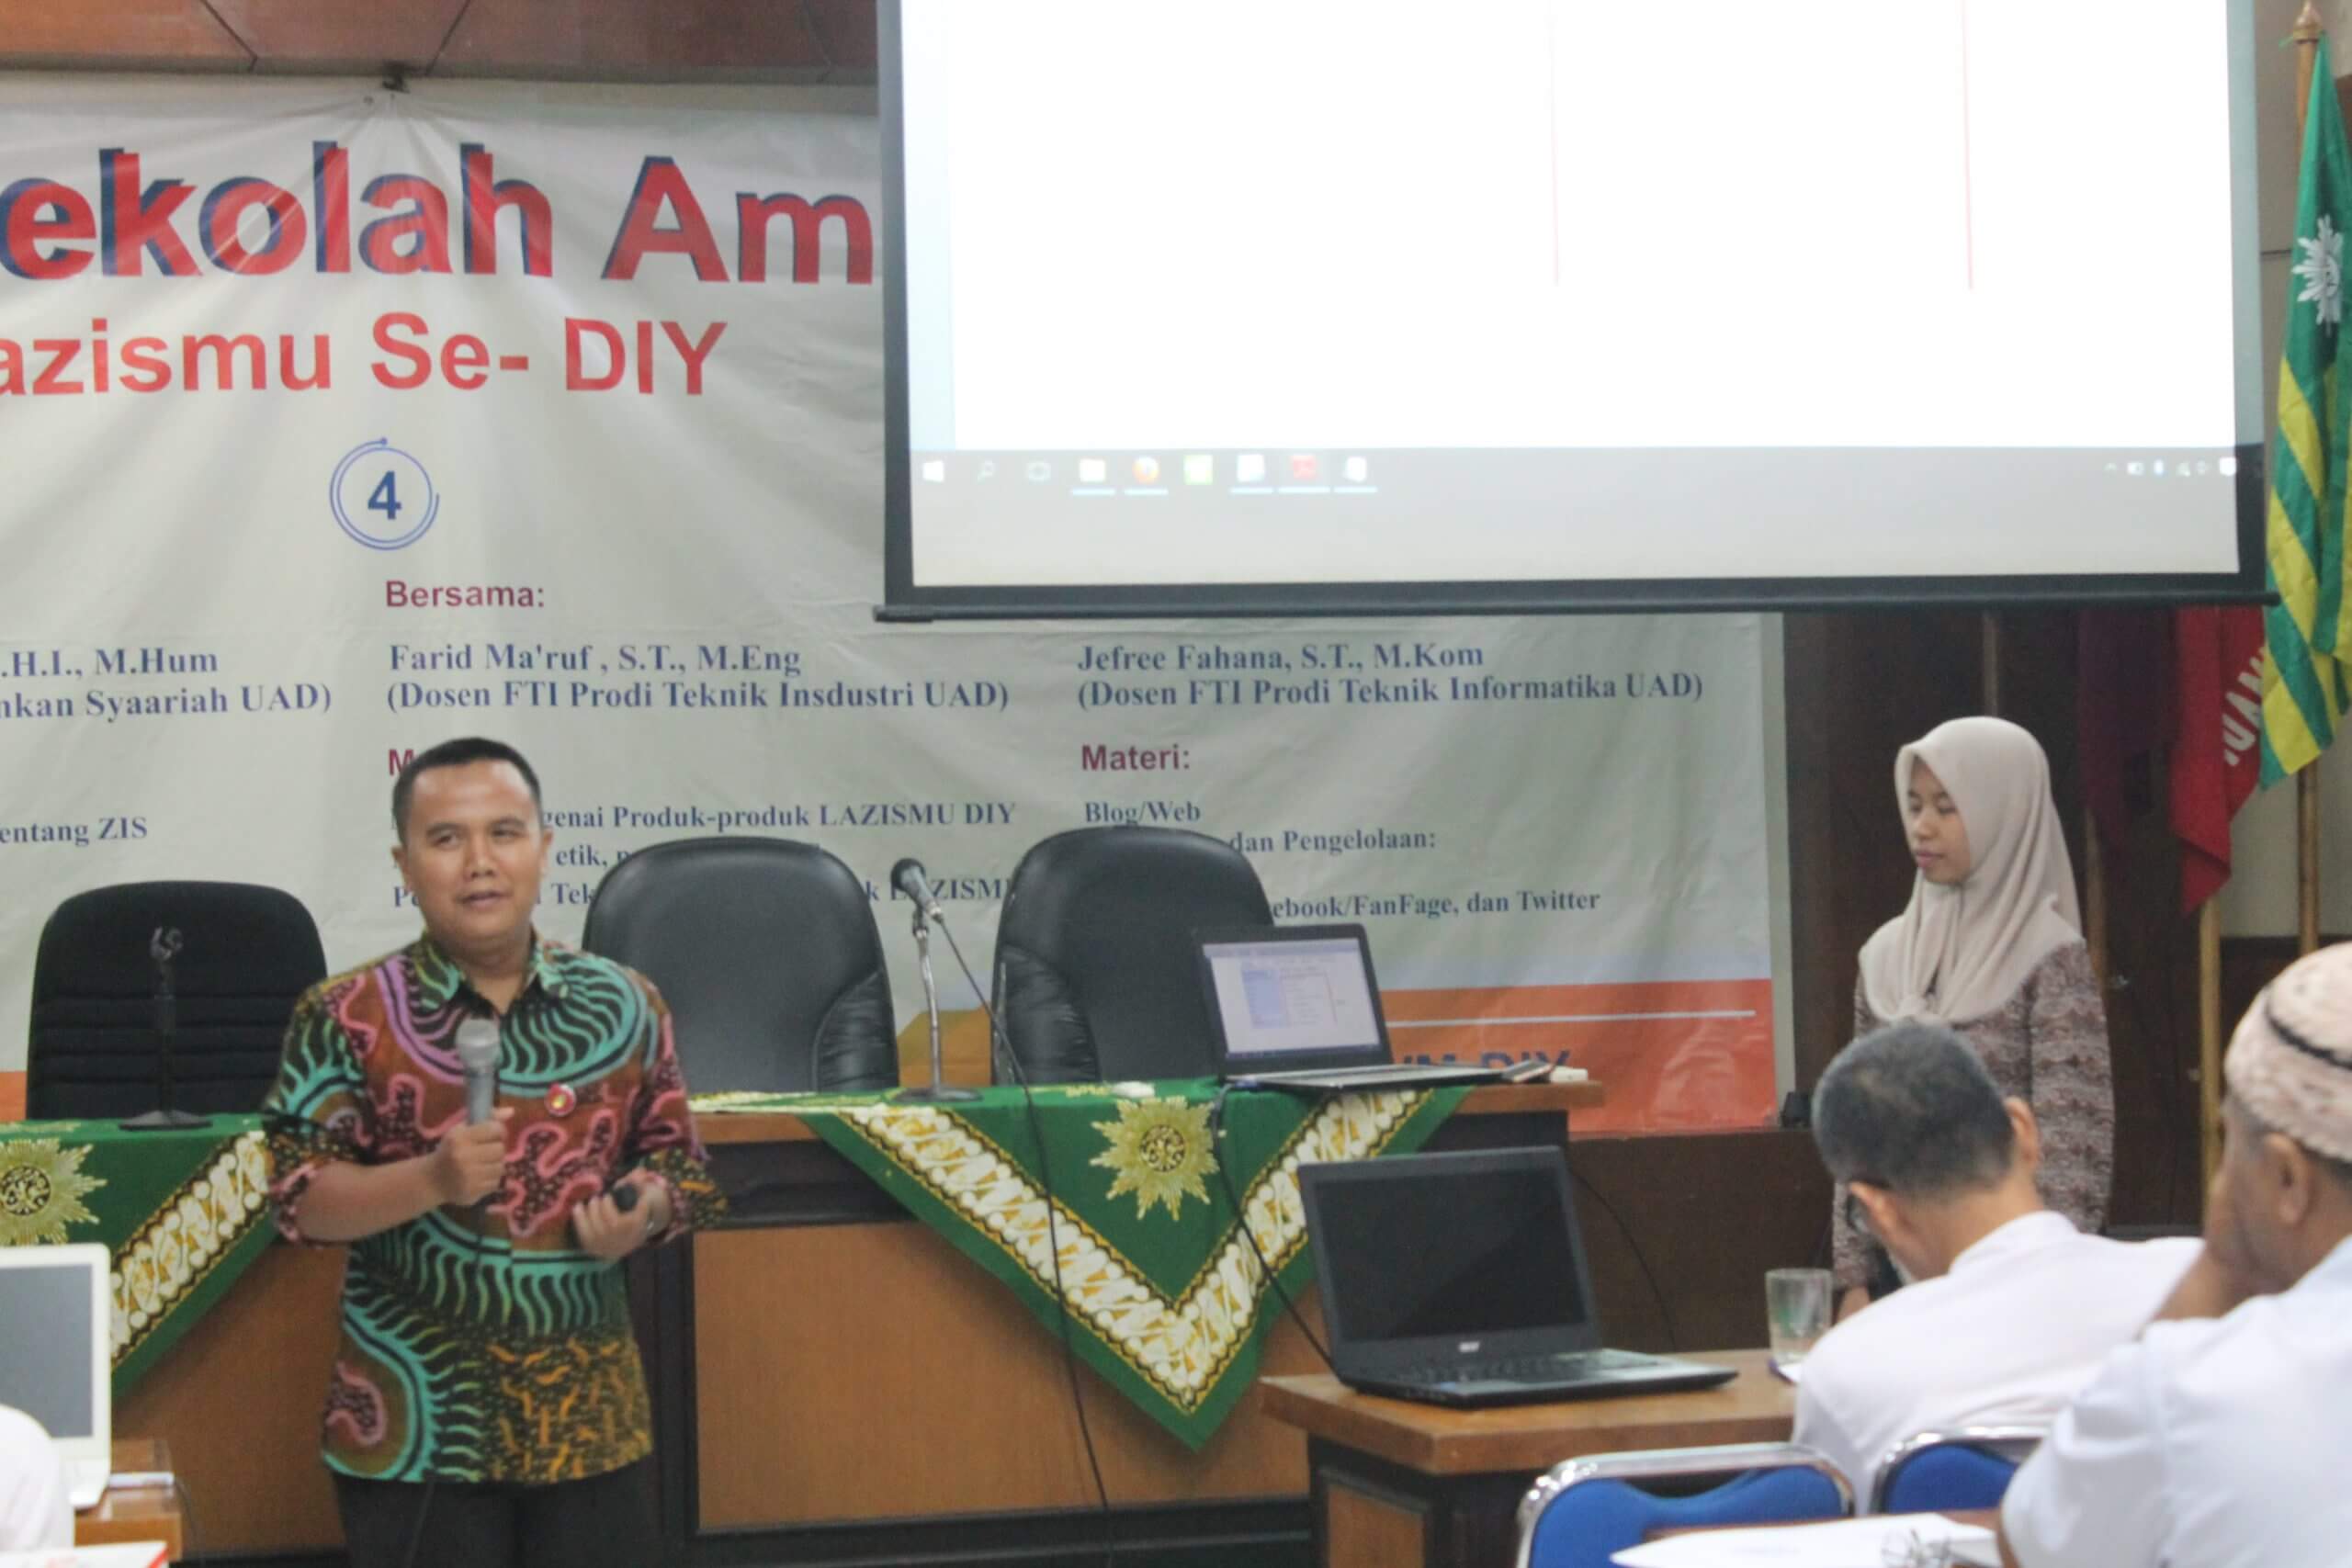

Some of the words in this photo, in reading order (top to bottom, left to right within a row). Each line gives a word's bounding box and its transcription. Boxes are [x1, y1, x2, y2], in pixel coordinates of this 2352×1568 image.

[0, 141, 553, 280] ekolah
[599, 155, 874, 285] Am
[370, 311, 529, 390] Se-
[565, 317, 728, 396] DIY
[367, 469, 401, 521] 4
[385, 581, 545, 608] Bersama:
[95, 647, 219, 675] M.Hum
[390, 644, 472, 671] Farid
[617, 645, 686, 673] S.T.,
[697, 645, 801, 676] M.Eng
[1078, 646, 1167, 671] Jefree
[1177, 646, 1292, 674] Fahana,
[1300, 645, 1363, 672] S.T.,
[1374, 644, 1484, 669] M.Kom
[85, 687, 228, 724] Syaariah
[241, 682, 332, 714] UAD)
[387, 681, 491, 713] (Dosen
[503, 681, 559, 706] FTI
[570, 681, 652, 707] Prodi
[663, 682, 767, 707] Teknik
[780, 682, 913, 707] Insdustri
[925, 682, 1009, 711] UAD)
[1078, 680, 1177, 711] (Dosen
[1189, 680, 1242, 705] FTI
[1253, 679, 1330, 705] Prodi
[1340, 678, 1440, 703] Teknik
[1450, 674, 1617, 701] Informatika
[1625, 672, 1703, 702] UAD)
[1081, 743, 1191, 771] Materi:
[98, 816, 148, 840] ZIS
[613, 805, 809, 832] Produk-produk
[820, 804, 955, 827] LAZISMU
[965, 802, 1016, 825] DIY
[1084, 800, 1201, 827] Blog/Web
[1230, 831, 1273, 853] dan
[1283, 829, 1436, 856] Pengelolaan:
[1466, 893, 1510, 913] dan
[1516, 890, 1601, 913] Twitter
